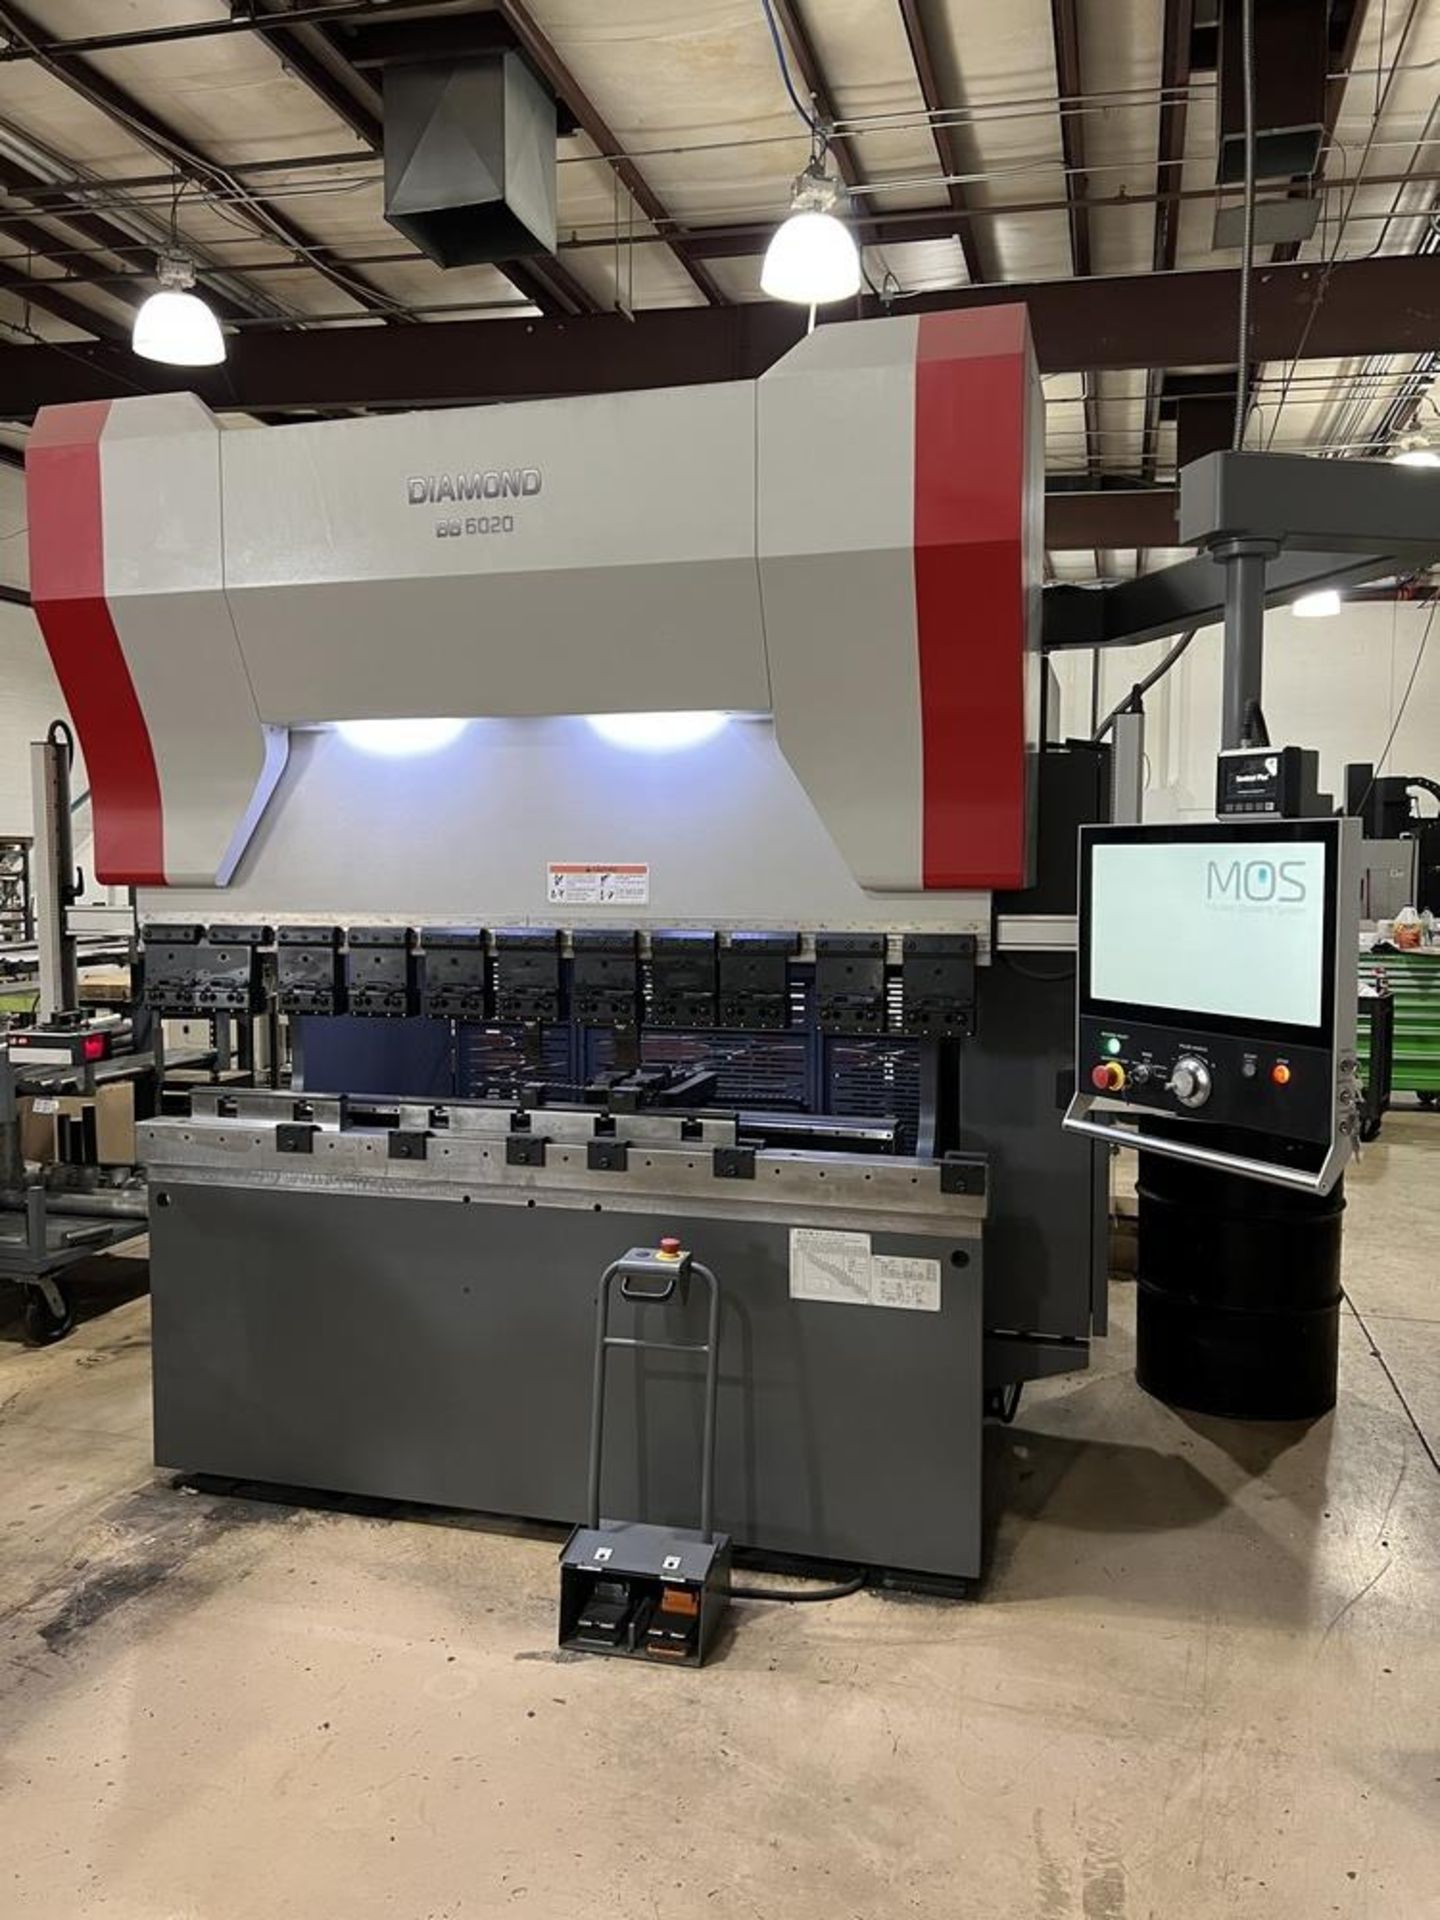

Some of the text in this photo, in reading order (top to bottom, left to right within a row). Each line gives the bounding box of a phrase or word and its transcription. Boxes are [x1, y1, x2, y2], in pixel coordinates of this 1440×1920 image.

[408, 468, 542, 505] DIAMOND
[465, 515, 514, 535] 6020
[1207, 860, 1306, 902] MOS
